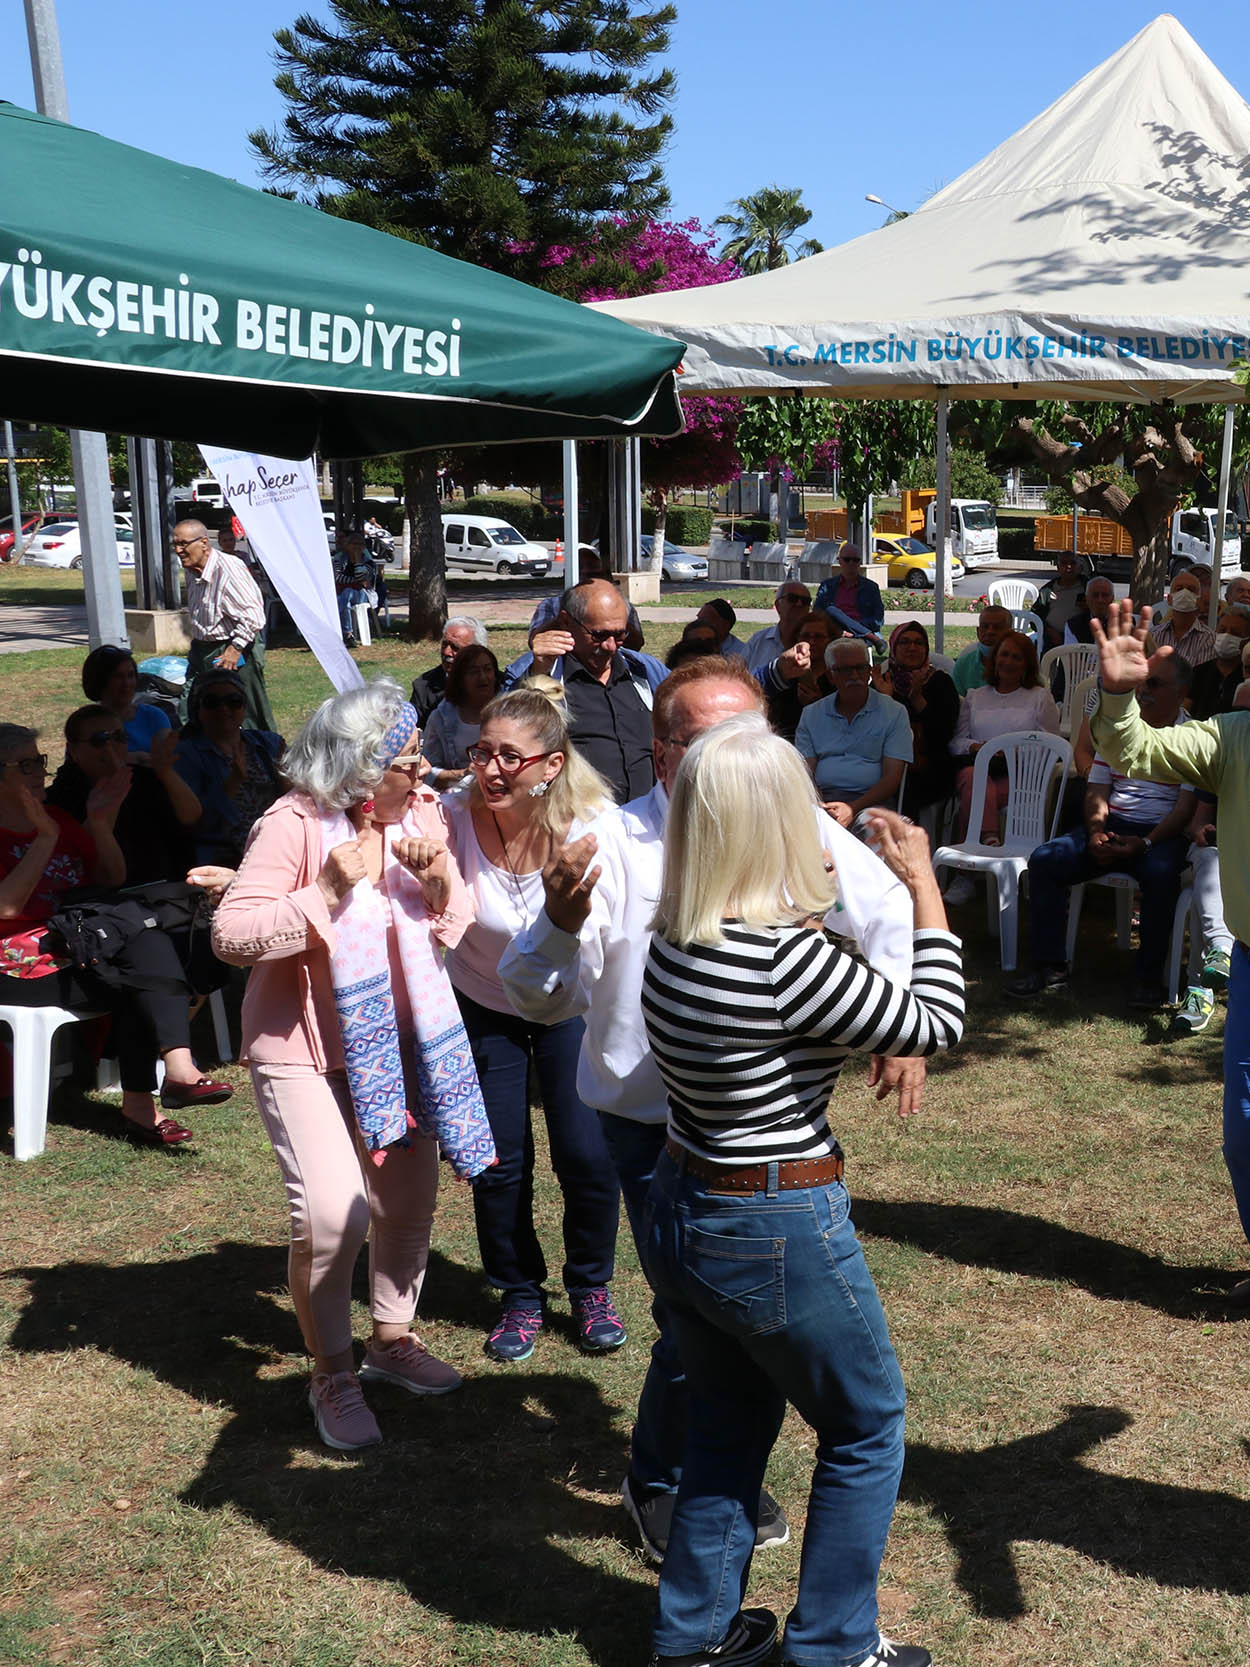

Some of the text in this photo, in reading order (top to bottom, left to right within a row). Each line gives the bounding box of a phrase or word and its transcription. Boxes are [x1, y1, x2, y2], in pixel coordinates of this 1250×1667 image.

[237, 299, 461, 377] BELEDİYESİ
[764, 344, 807, 366] T.C.
[813, 333, 916, 365] MERSİN
[927, 328, 1107, 366] BÜYÜKŞEHİR
[257, 466, 298, 490] Seçer
